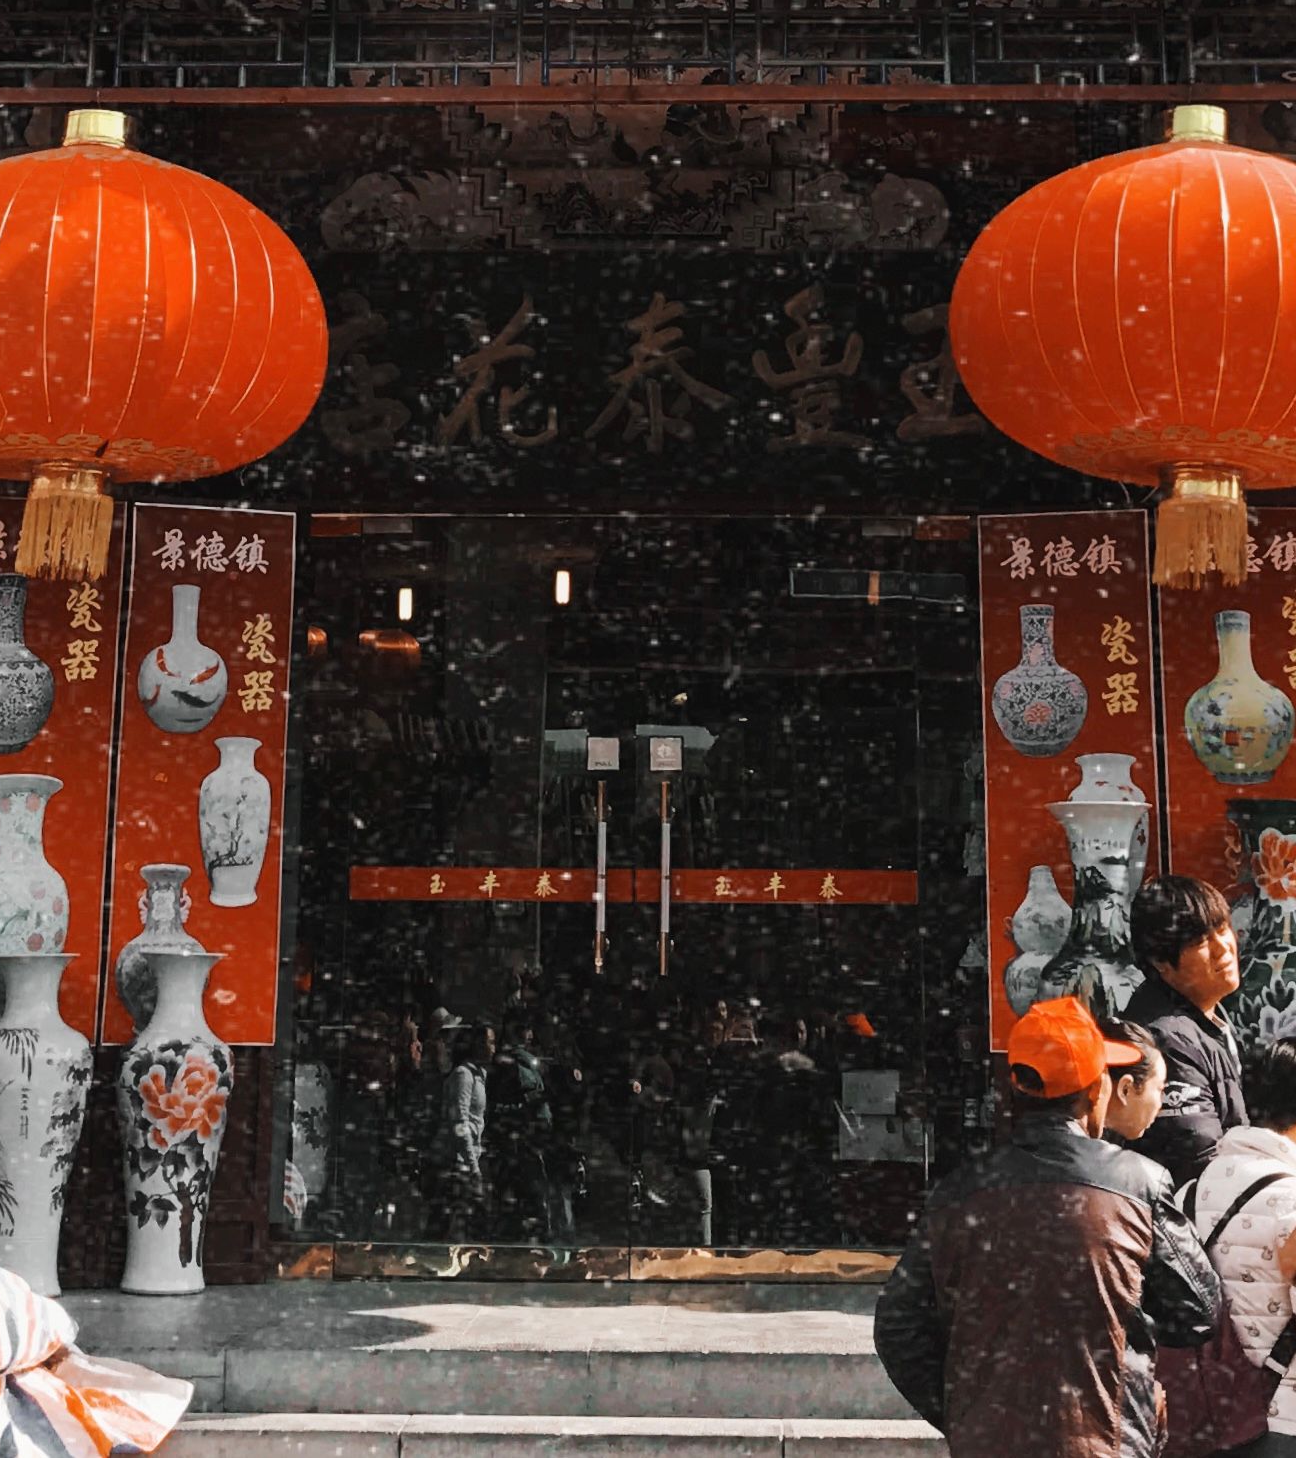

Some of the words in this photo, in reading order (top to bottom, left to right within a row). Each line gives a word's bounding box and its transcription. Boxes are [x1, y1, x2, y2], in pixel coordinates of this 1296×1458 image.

[152, 529, 270, 575] 景德镇
[1000, 534, 1124, 580] 景德镇
[60, 580, 103, 683] 瓷器
[237, 613, 278, 714] 瓷器
[1100, 614, 1140, 717] 瓷器
[429, 871, 559, 898] 玉丰泰
[714, 872, 844, 900] 玉丰泰
